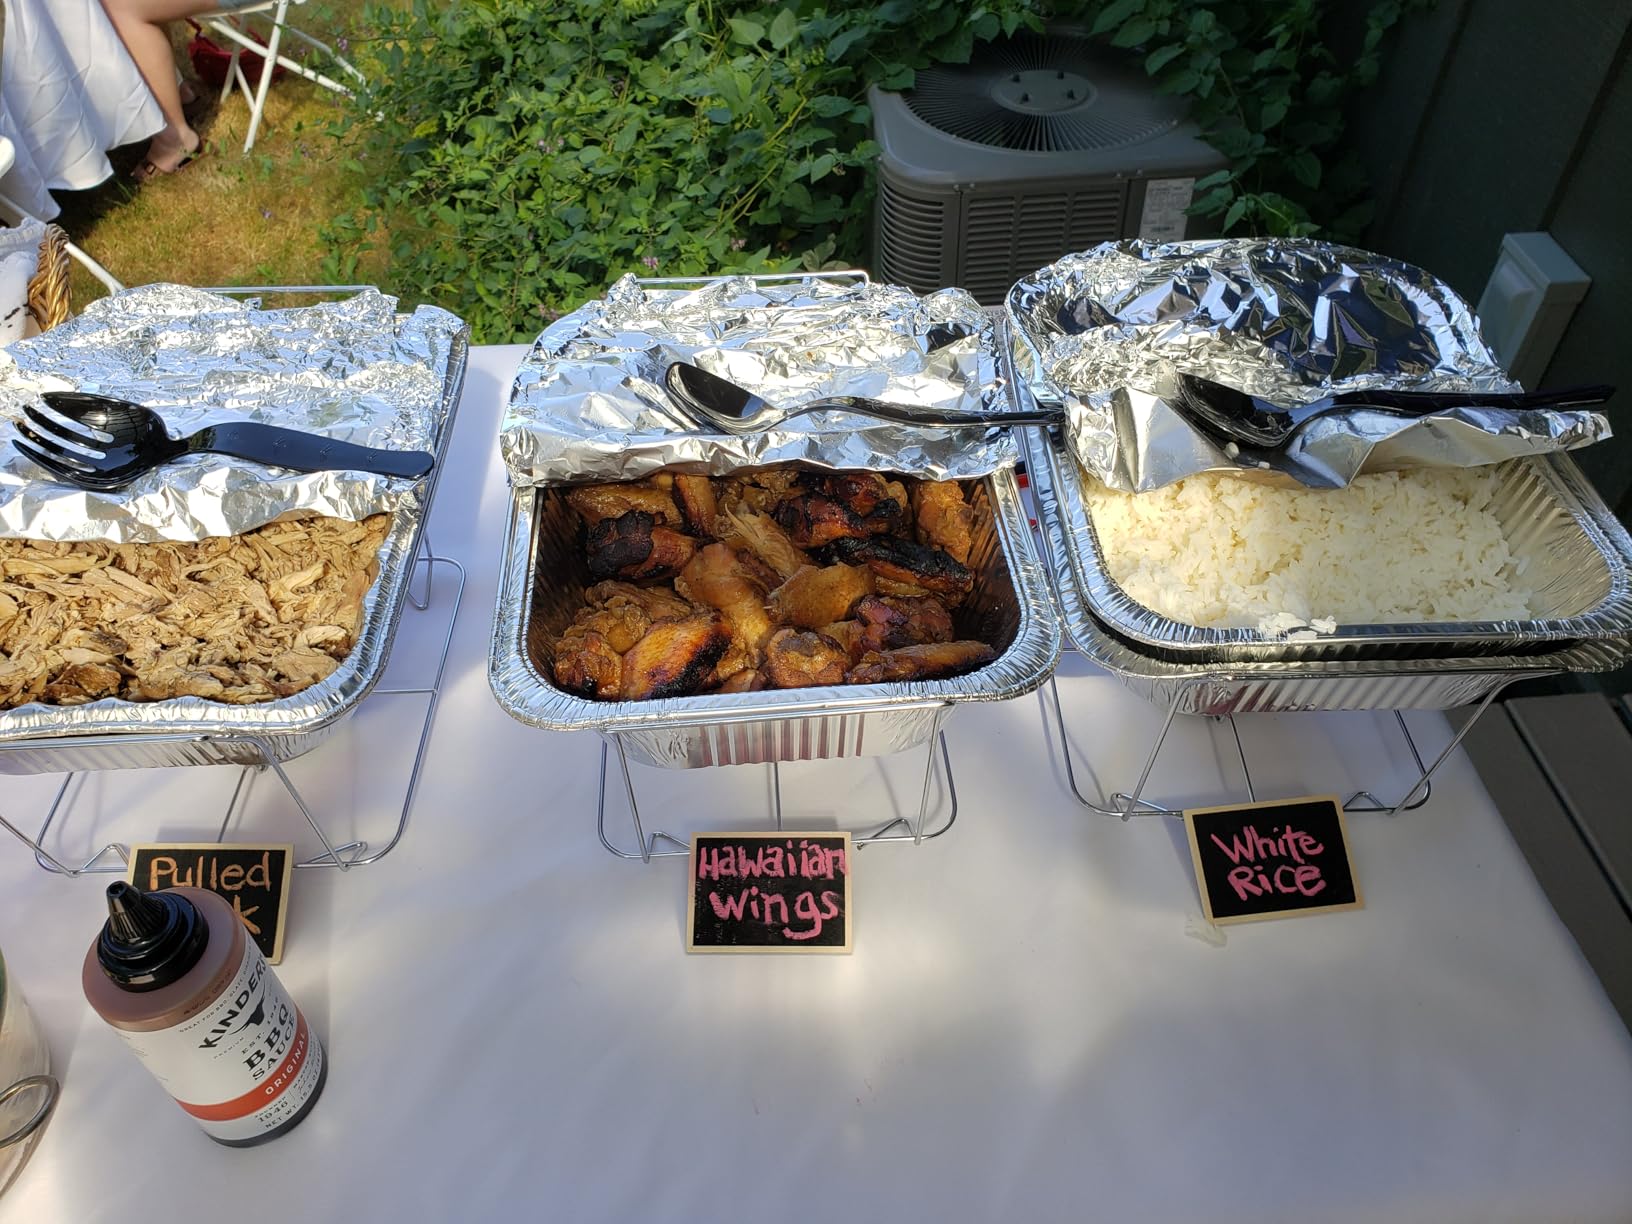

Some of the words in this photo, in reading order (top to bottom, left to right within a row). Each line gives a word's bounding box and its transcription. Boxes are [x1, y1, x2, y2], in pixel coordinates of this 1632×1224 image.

[699, 839, 848, 881] Hawaiian
[1210, 824, 1325, 864] White
[150, 851, 271, 892] Pulled
[1227, 864, 1327, 901] Rice
[243, 1003, 289, 1072] BBQ
[252, 1012, 295, 1081] SAUCE
[265, 1032, 306, 1095] ORIGINAL
